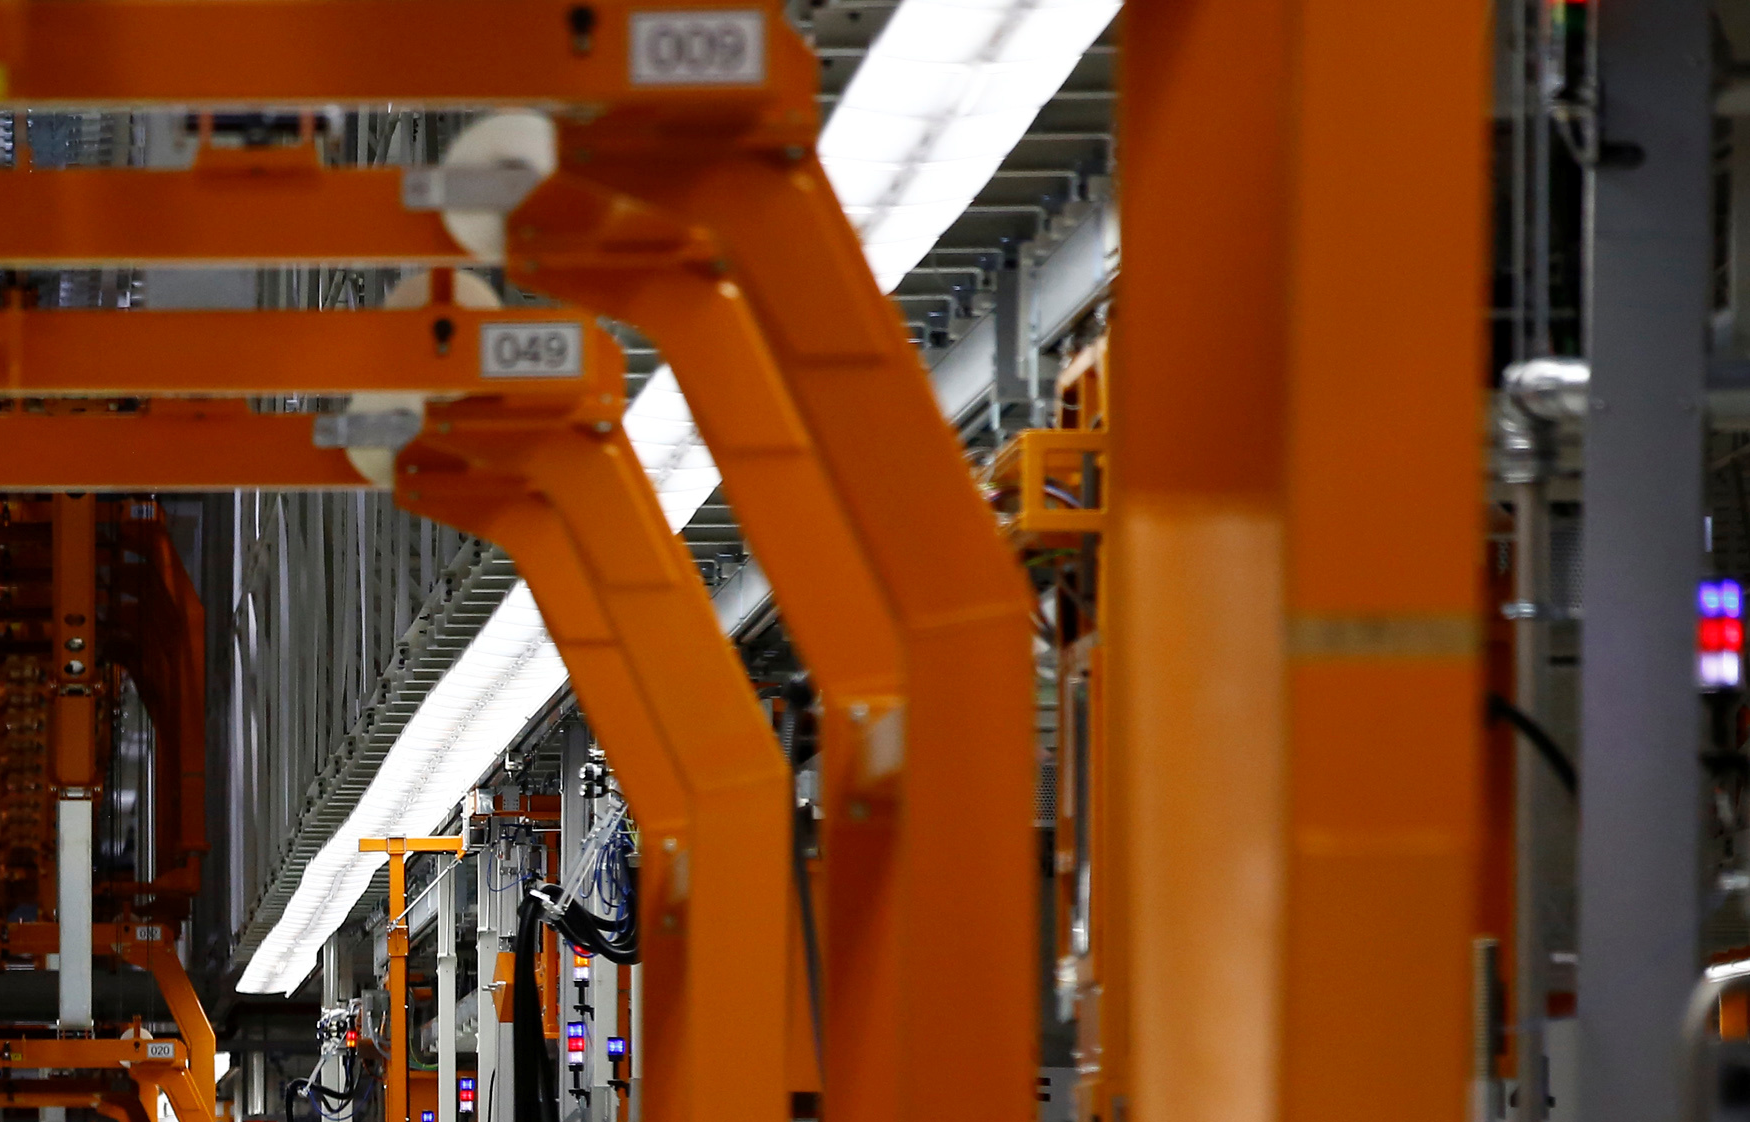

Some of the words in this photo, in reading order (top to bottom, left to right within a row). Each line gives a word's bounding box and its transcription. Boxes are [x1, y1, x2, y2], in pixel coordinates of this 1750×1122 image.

[648, 22, 747, 75] 009
[492, 331, 569, 370] 049
[150, 1045, 171, 1056] 020
